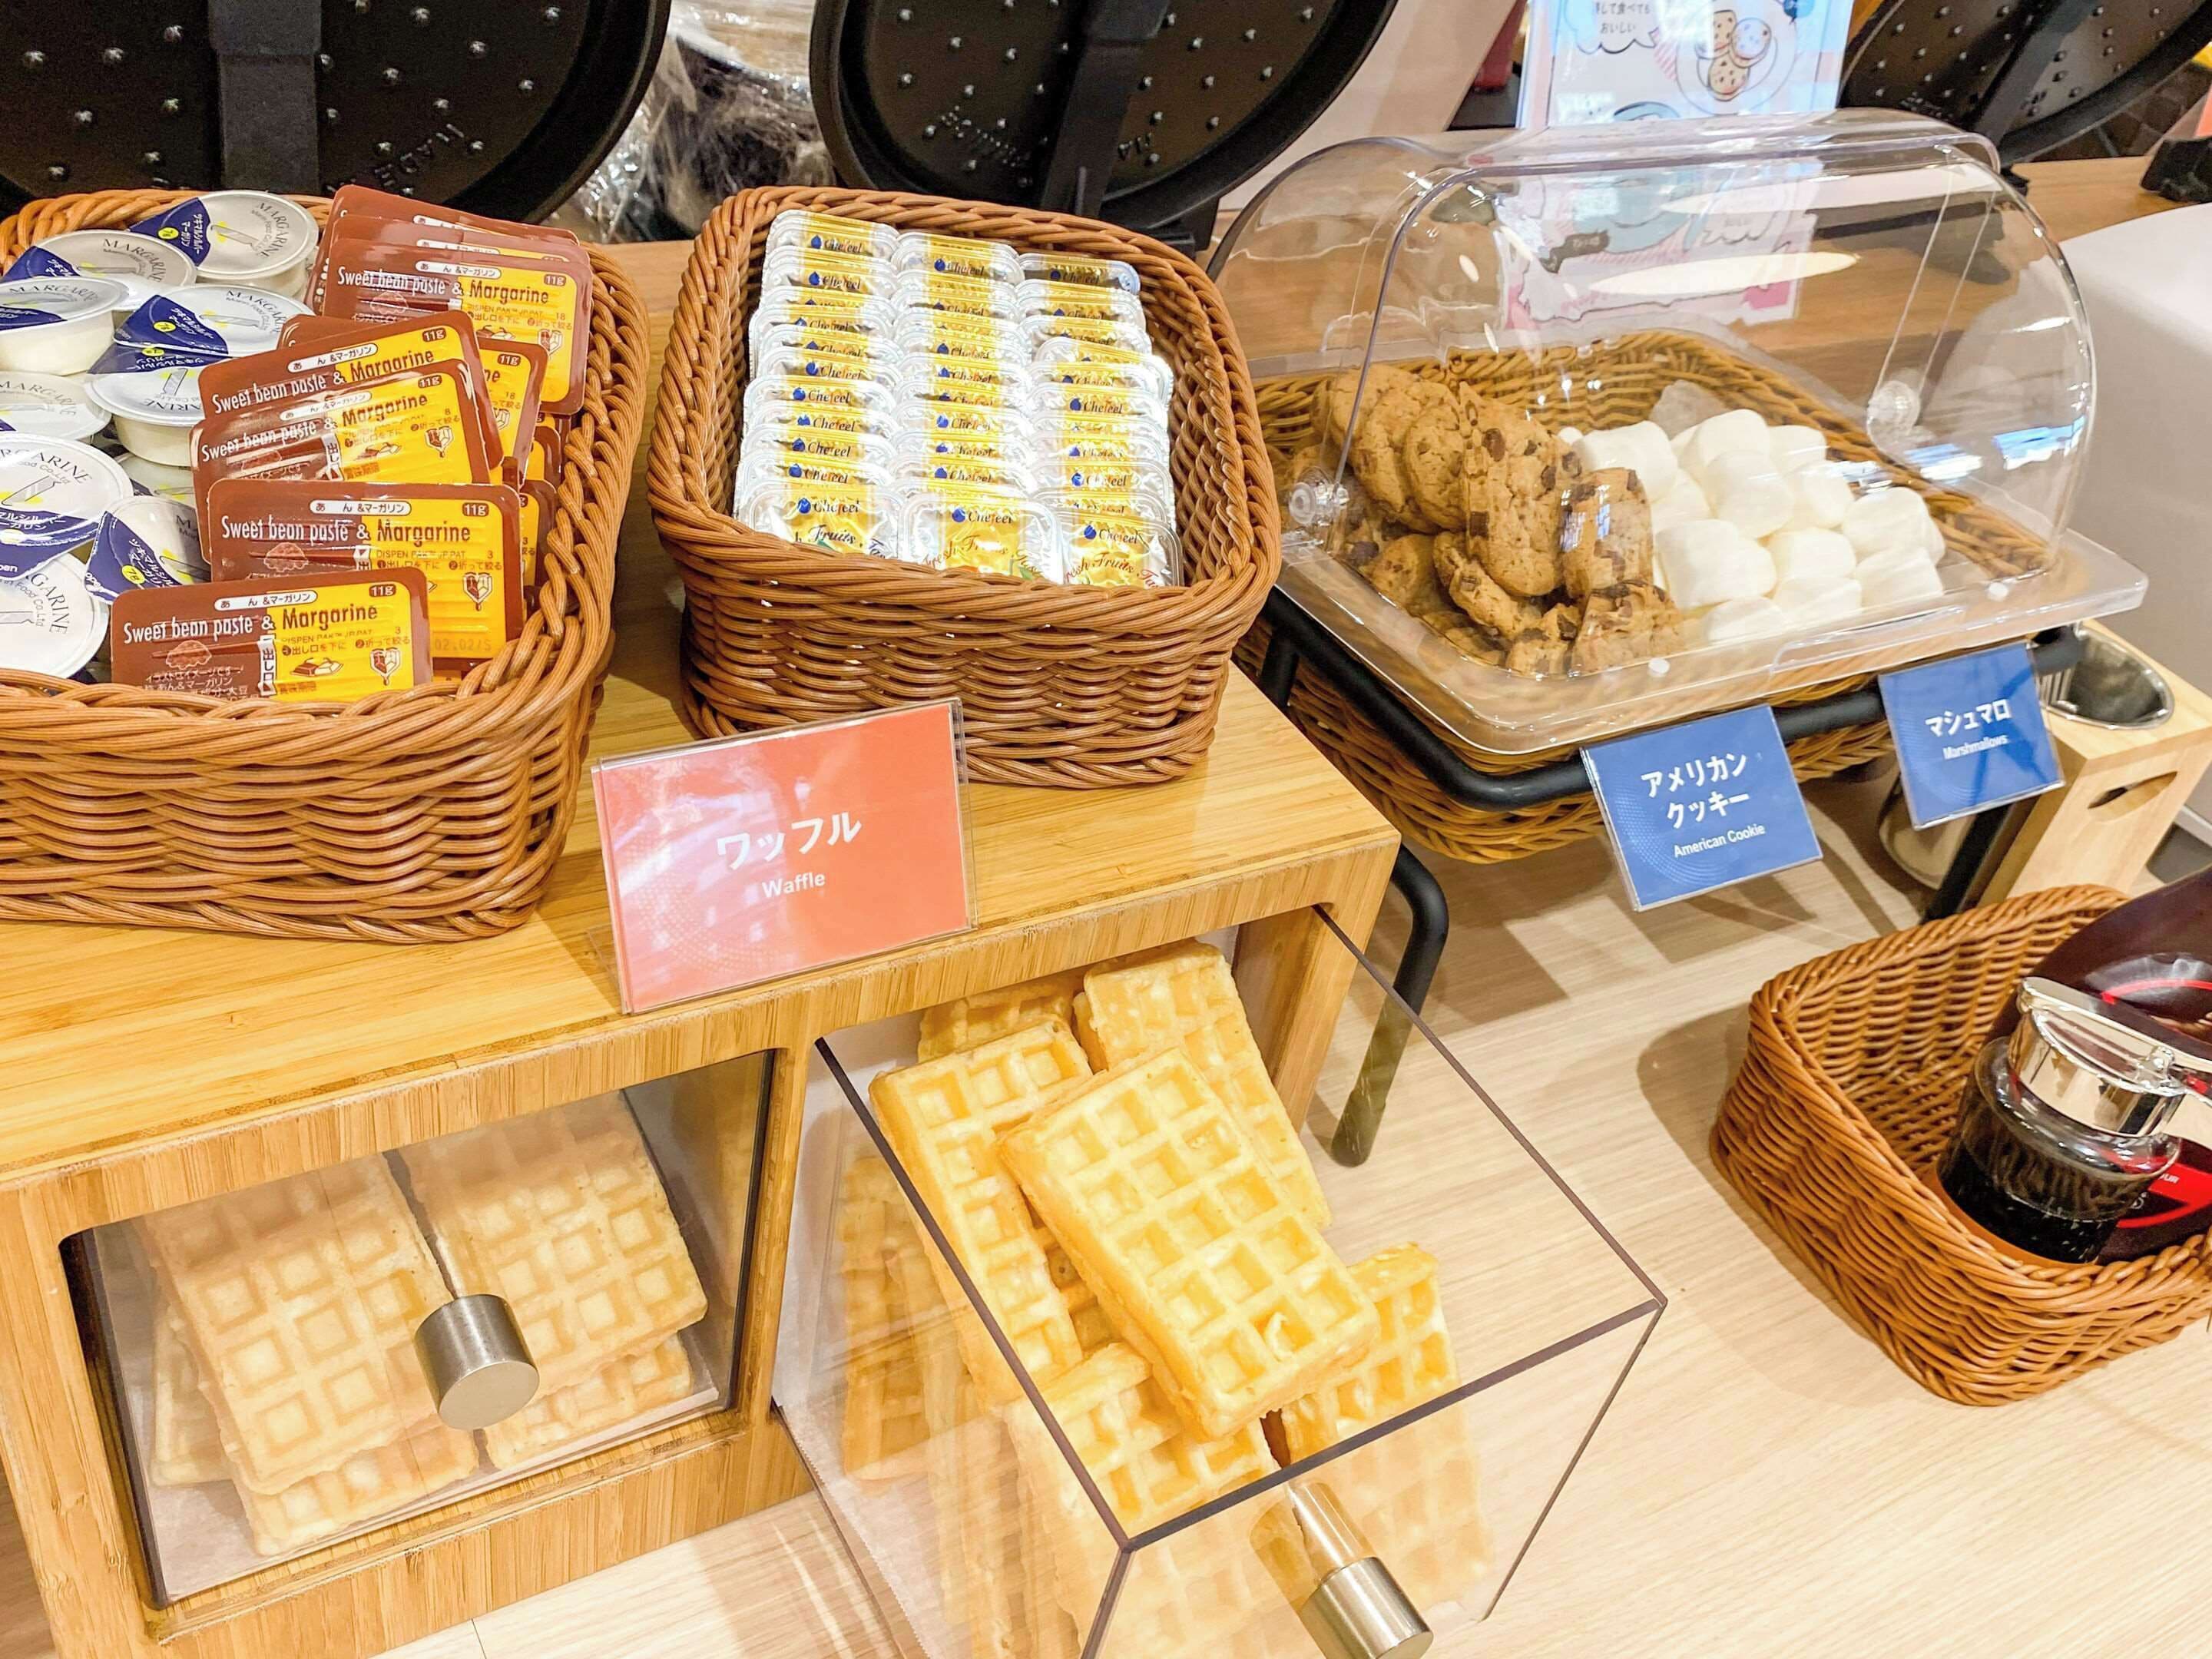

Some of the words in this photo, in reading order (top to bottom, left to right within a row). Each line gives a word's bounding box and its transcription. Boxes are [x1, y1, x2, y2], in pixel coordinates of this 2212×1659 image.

[1600, 22, 1635, 34] おいしい
[256, 203, 290, 257] MARGARINE
[102, 238, 167, 283] MARGARINE
[338, 267, 374, 286] Sweet
[379, 269, 409, 290] bean
[412, 276, 445, 296] paste
[452, 281, 464, 295] &
[469, 280, 549, 305] Margarine
[545, 274, 565, 285] 11g
[424, 329, 444, 341] 11g
[499, 355, 519, 365] 11g
[211, 390, 253, 414] Sweet
[254, 380, 287, 402] bean
[290, 374, 326, 397] paste
[333, 371, 346, 385] &
[350, 349, 435, 382] Margarine
[419, 376, 441, 387] 11g
[201, 441, 239, 462] Sweet
[243, 428, 279, 450] bean
[282, 419, 317, 446] paste
[324, 417, 338, 431] &
[342, 394, 427, 426] Margarine
[465, 505, 487, 515] 11g
[222, 515, 263, 540] Sweet
[268, 515, 304, 540] bean
[310, 519, 349, 546] paste
[356, 525, 370, 541] &
[377, 518, 471, 547] Margarine
[809, 525, 856, 545] Fruits
[1065, 558, 1089, 583] resh
[1092, 552, 1134, 573] Fruits
[26, 573, 70, 634] GARINE
[370, 585, 396, 597] 11g
[123, 622, 167, 644] Sweet
[171, 617, 209, 638] bean
[214, 616, 253, 642] paste
[260, 614, 276, 631] &
[283, 604, 378, 631] Margarine
[395, 626, 402, 634] 3
[1925, 699, 2012, 737] マシュマロ
[1942, 734, 2010, 760] Marshmallows
[1641, 753, 1747, 798] アメリカン
[1667, 791, 1750, 830] クッキー
[716, 811, 862, 871] ワッフル
[1674, 835, 1727, 858] American
[1727, 823, 1766, 843] Cookie
[761, 871, 826, 898] Waffle
